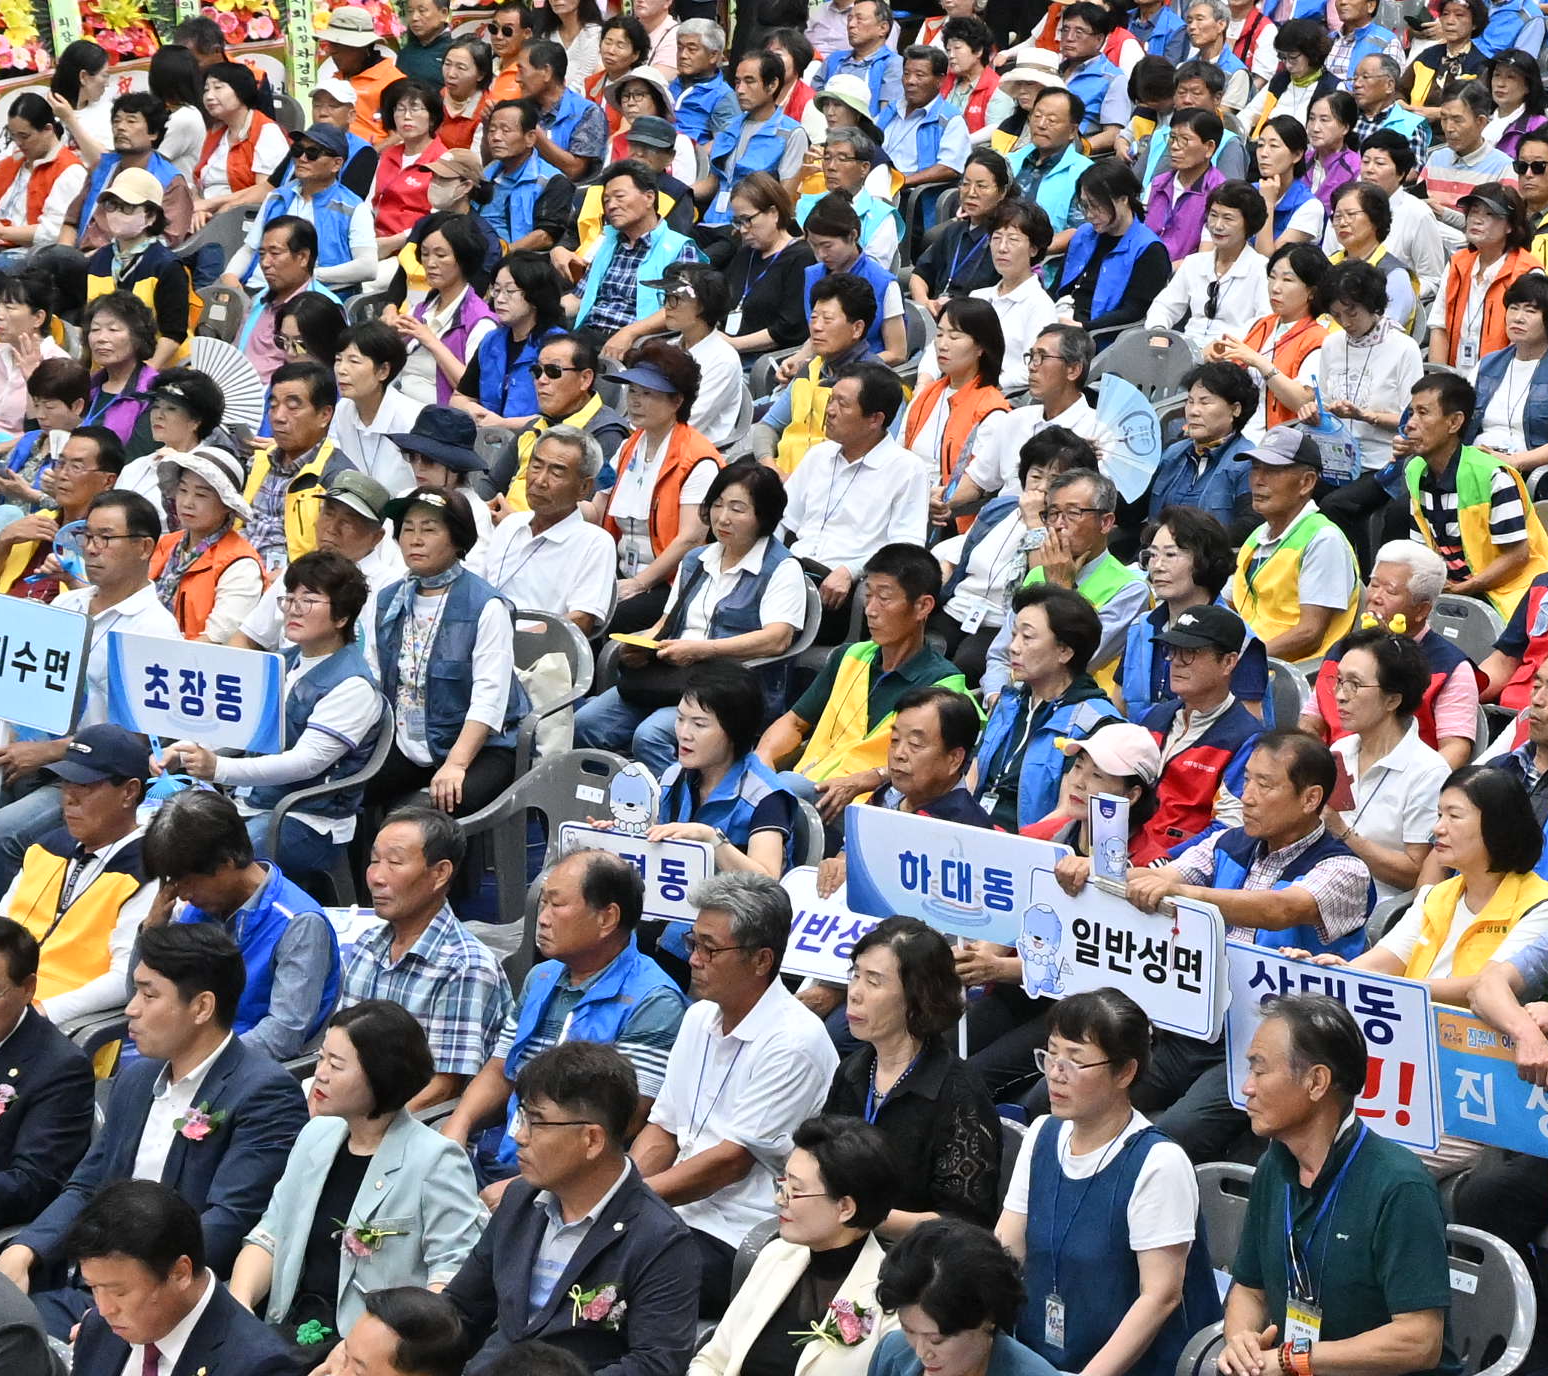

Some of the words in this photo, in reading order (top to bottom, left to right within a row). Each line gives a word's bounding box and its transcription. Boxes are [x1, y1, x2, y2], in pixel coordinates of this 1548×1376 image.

[144, 663, 243, 723] 초장동
[898, 850, 1014, 912] 하대동
[1071, 917, 1202, 995] 일반성면
[1248, 966, 1402, 1046] 상대동
